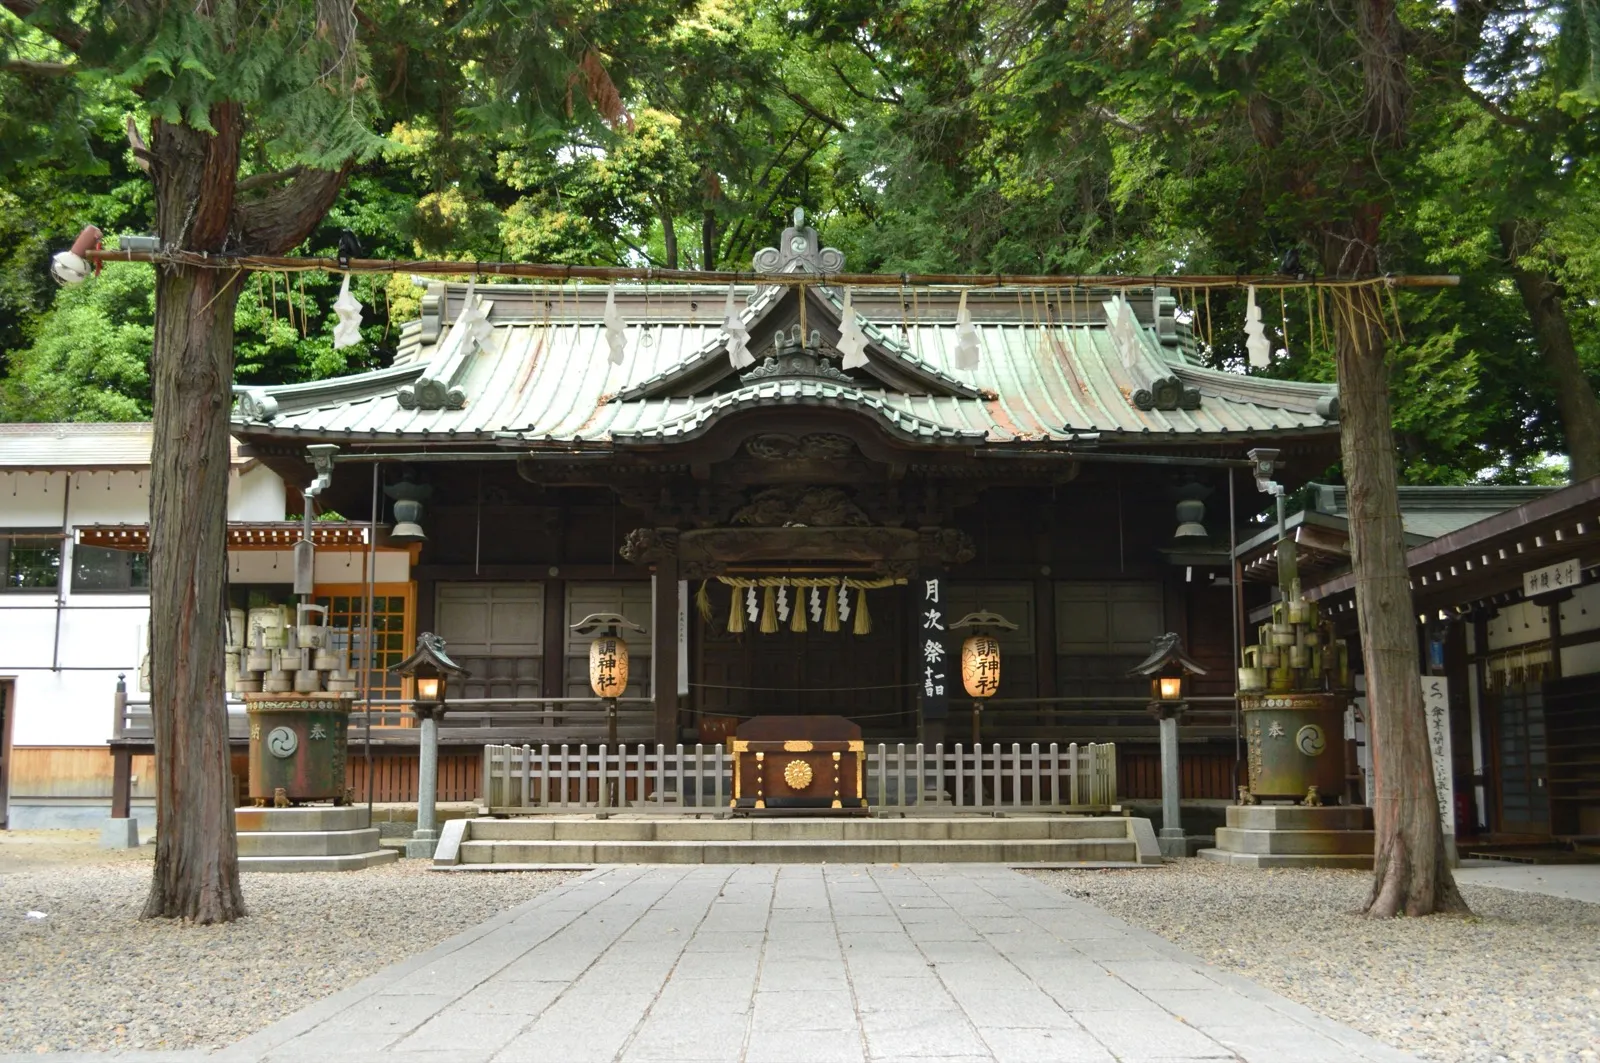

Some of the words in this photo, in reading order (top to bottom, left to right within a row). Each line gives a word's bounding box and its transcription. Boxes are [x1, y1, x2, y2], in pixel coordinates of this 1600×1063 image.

[923, 579, 945, 663] 月次祭
[597, 640, 617, 691] 調神社
[975, 639, 999, 694] 調神社
[924, 666, 934, 697] 十五日
[934, 673, 945, 695] 一日
[309, 723, 326, 740] 奉
[1268, 720, 1285, 738] 奉
